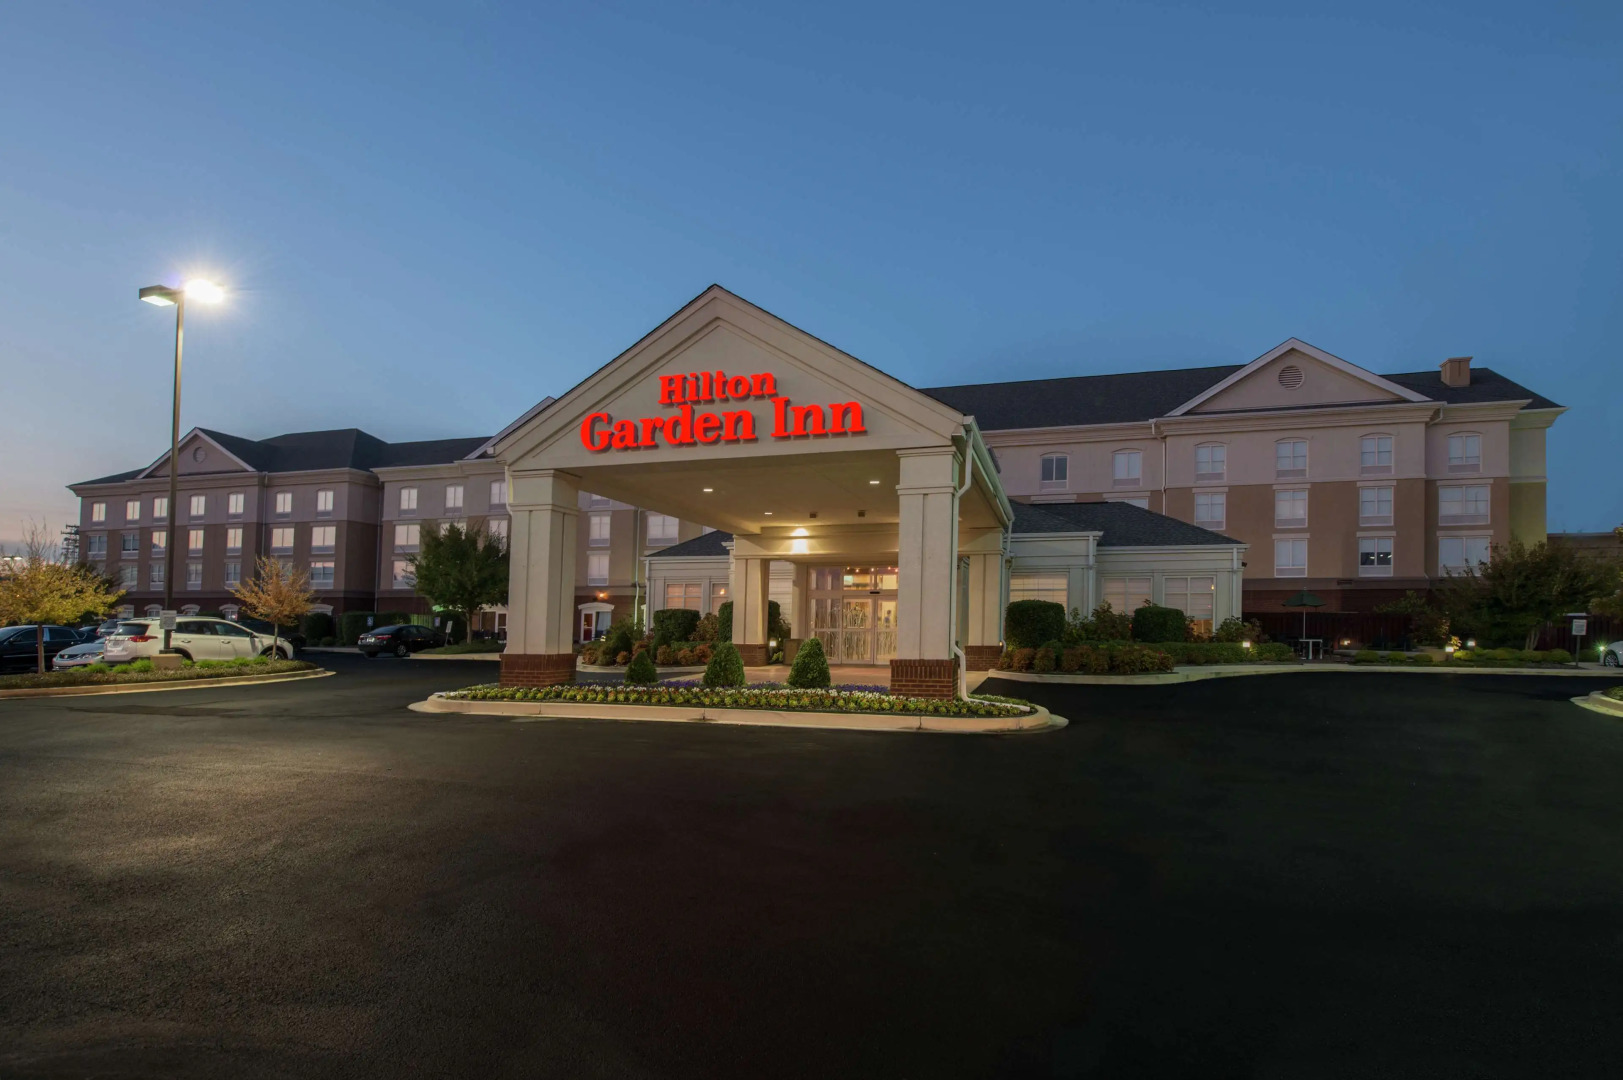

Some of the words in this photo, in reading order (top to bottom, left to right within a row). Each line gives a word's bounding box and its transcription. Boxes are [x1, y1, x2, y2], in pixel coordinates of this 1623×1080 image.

[657, 370, 777, 404] Hilton
[580, 404, 756, 451] Garden
[770, 397, 866, 437] Inn
